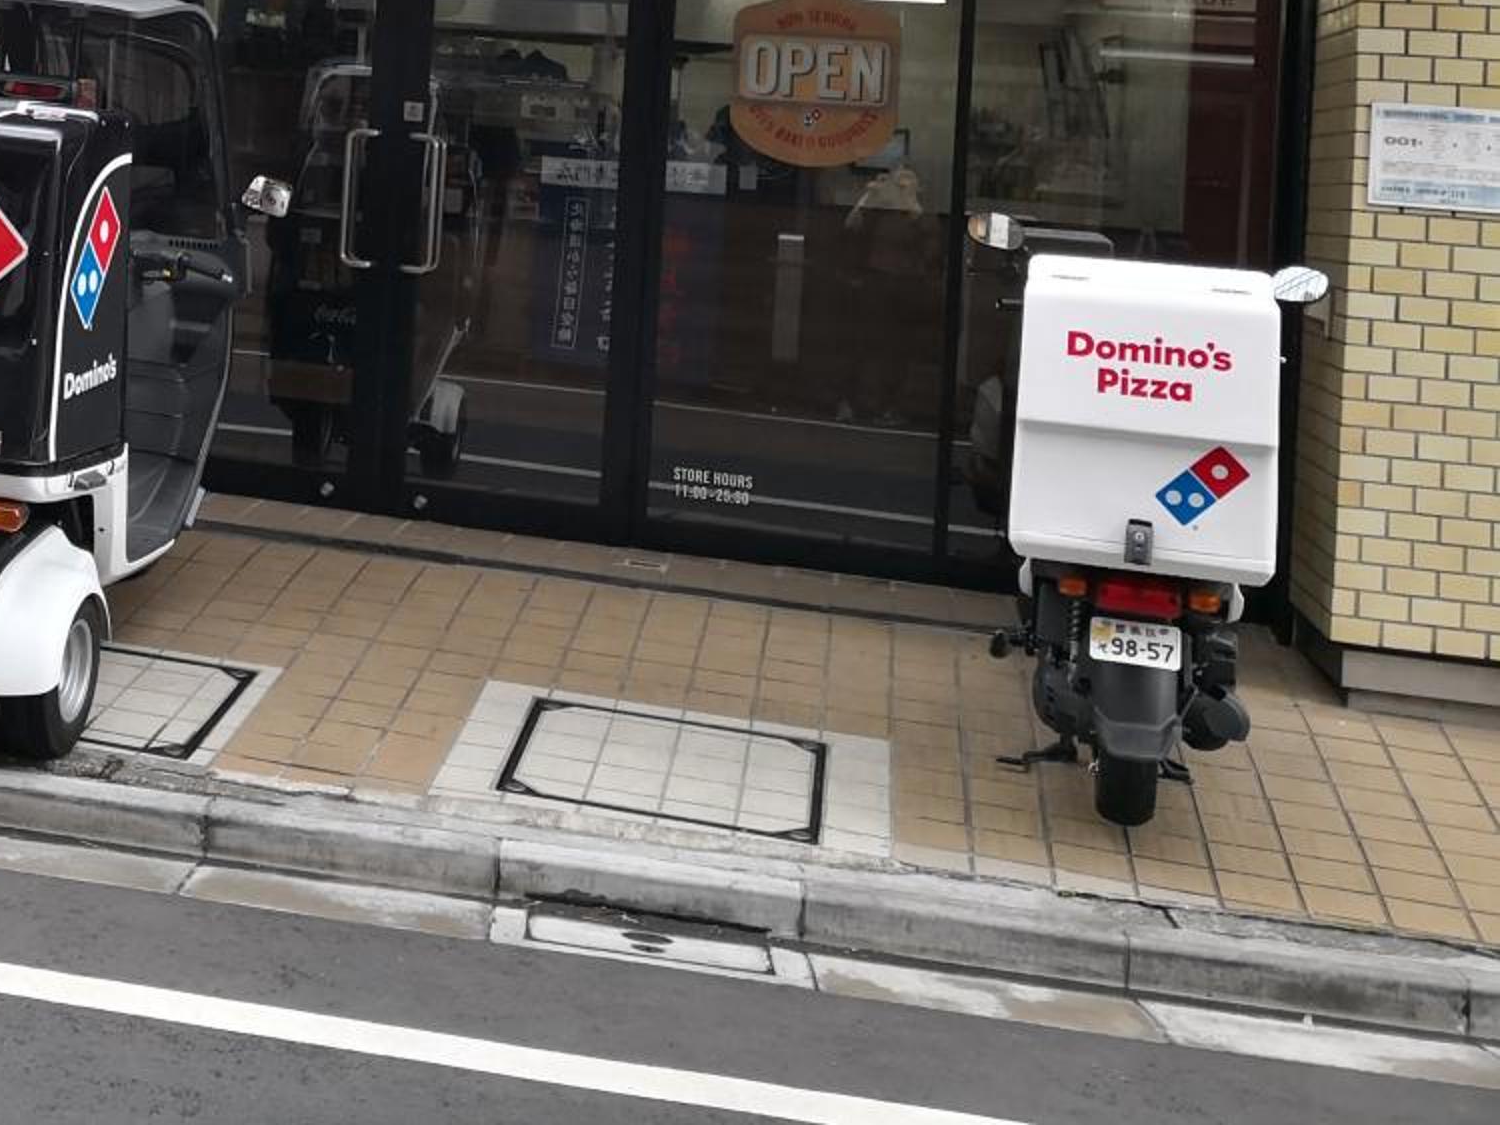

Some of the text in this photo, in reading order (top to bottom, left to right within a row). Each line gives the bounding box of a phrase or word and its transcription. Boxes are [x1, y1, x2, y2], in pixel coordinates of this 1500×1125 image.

[746, 39, 891, 105] OPEN
[1066, 330, 1233, 372] Domino's
[64, 354, 117, 400] Domino's
[1096, 367, 1194, 403] Pizza
[673, 466, 754, 490] STORE HOURS
[1111, 636, 1174, 664] 98-57
